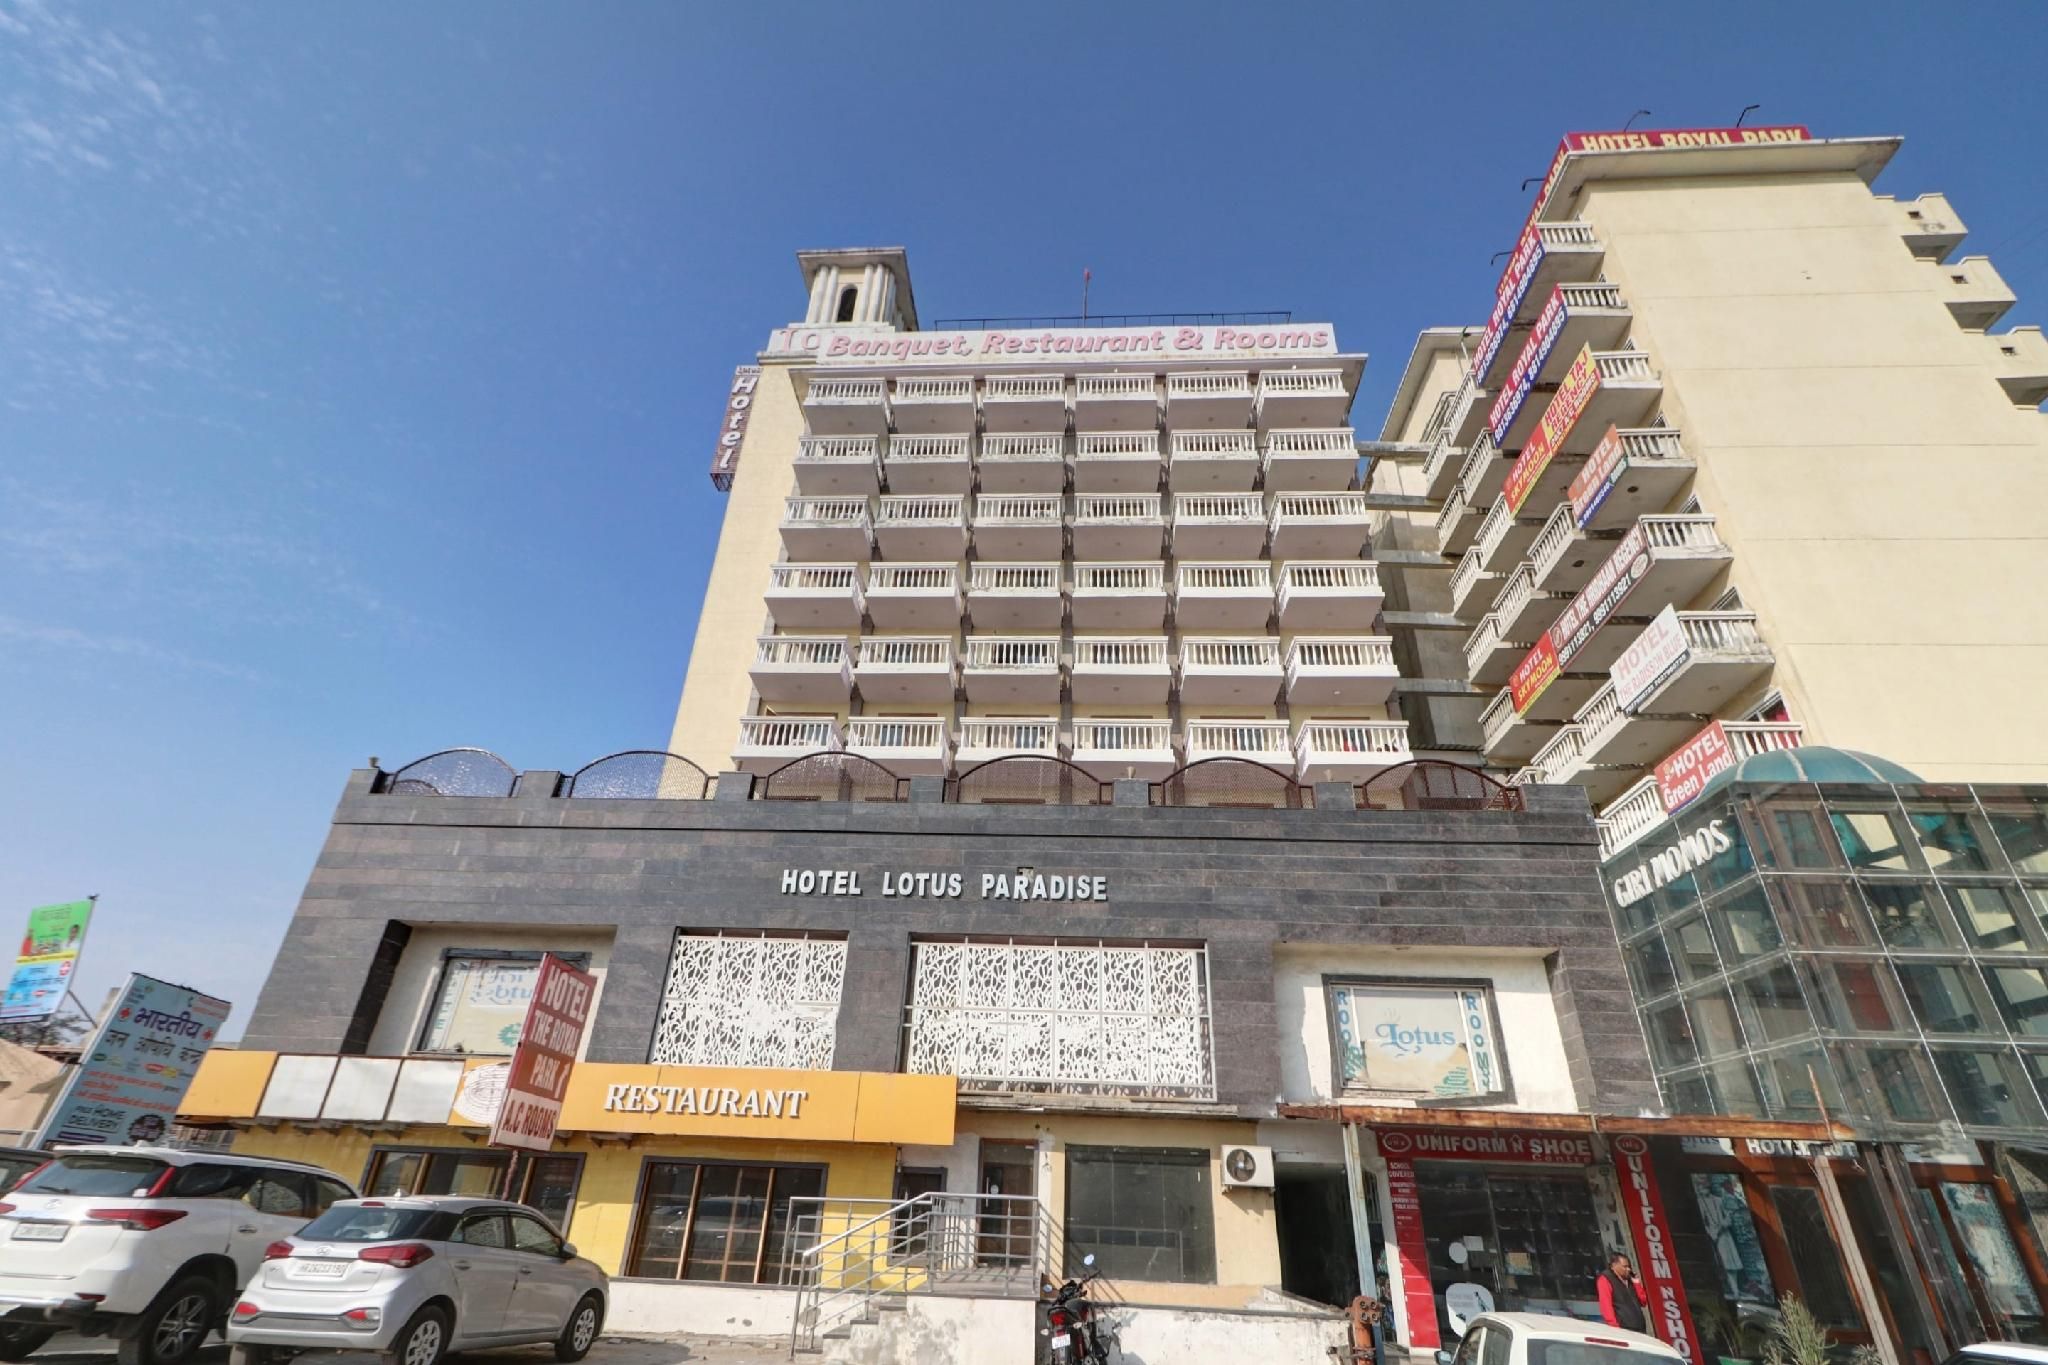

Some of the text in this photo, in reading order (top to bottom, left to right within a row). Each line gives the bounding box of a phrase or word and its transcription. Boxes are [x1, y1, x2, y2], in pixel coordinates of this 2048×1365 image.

[1472, 326, 1494, 369] HOTEL
[1493, 280, 1516, 327] ROYAL
[1514, 232, 1537, 277] PARK
[826, 327, 1329, 360] Banquet, Restaurant & Rooms
[1489, 291, 1560, 428] HOTEL ROYAL PARK
[1544, 380, 1571, 426] HOTEL
[1569, 350, 1588, 380] TAJ
[1552, 366, 1588, 431] REGENCY
[720, 377, 758, 469] Hotel
[1510, 442, 1545, 502] SKYMOON
[1512, 441, 1536, 483] HOTEL
[1582, 437, 1612, 483] HOTEL
[1559, 608, 1579, 642] HOTEL
[1519, 647, 1543, 683] HOTEL
[1618, 622, 1669, 678] HOTEL
[1518, 652, 1553, 702] SKYMOON
[1663, 745, 1733, 808] Green Land
[1672, 729, 1725, 778] HOTEL
[1650, 819, 1730, 888] MOMOS
[781, 869, 1108, 901] HOTEL LOTUS PARADISE
[540, 965, 590, 1023] HOTEL
[134, 1007, 204, 1039] भारतीय
[530, 1009, 580, 1057] THE ROYAL
[1376, 1022, 1456, 1051] Lotus
[529, 1054, 560, 1092] PARK
[604, 1083, 808, 1118] RESTAURANT
[1416, 1134, 1509, 1153] UNIFORM
[1529, 1138, 1591, 1156] SHOE
[1627, 1155, 1673, 1279] UNIFORM
